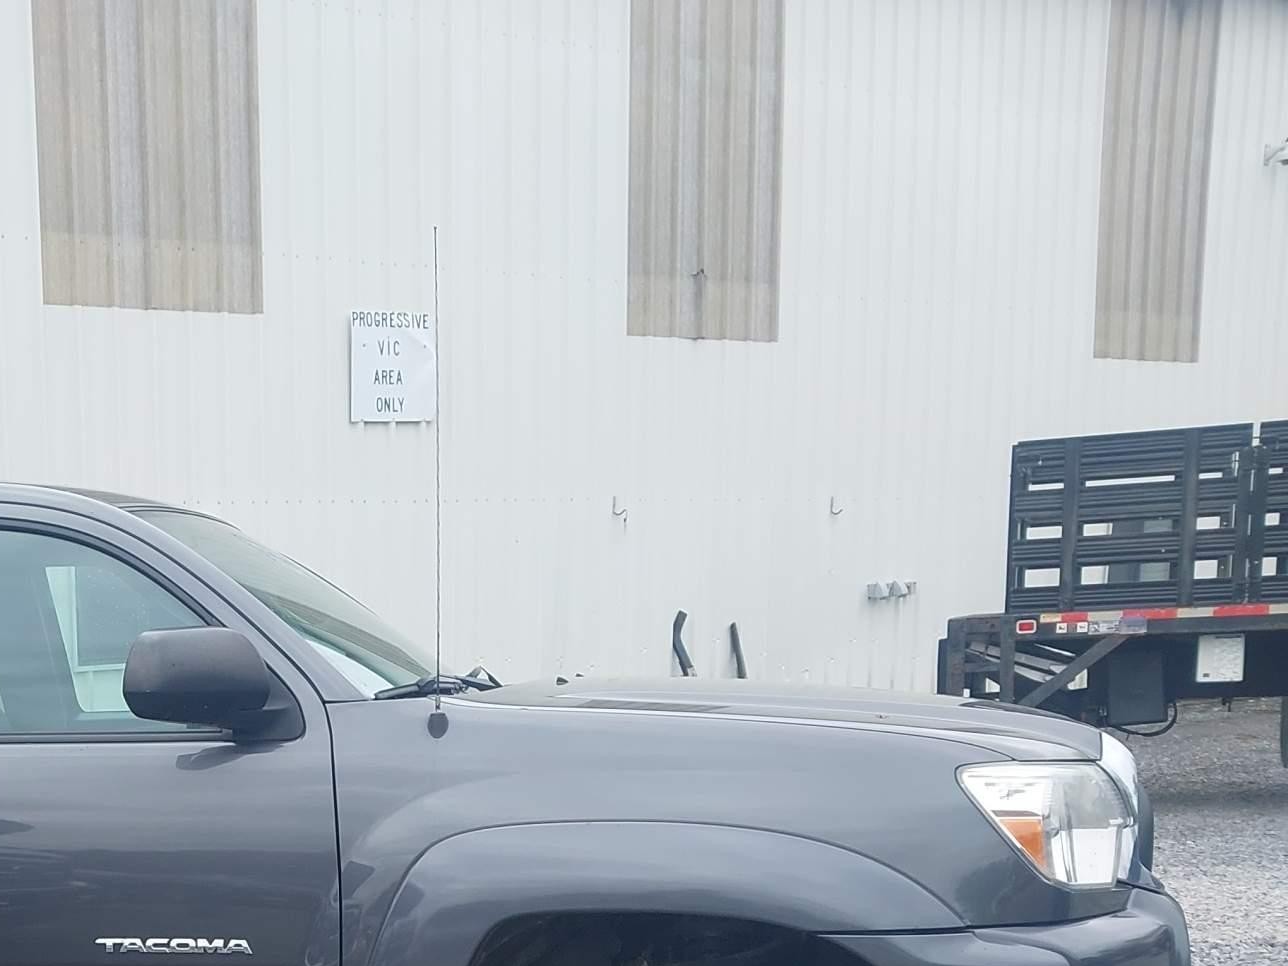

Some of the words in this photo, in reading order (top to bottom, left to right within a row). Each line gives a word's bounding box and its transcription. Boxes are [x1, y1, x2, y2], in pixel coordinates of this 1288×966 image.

[351, 311, 429, 329] PROGRESSIVE
[377, 338, 400, 356] VIC
[373, 369, 403, 385] AREA
[376, 397, 404, 413] ONLY
[95, 937, 253, 955] TACOMA
